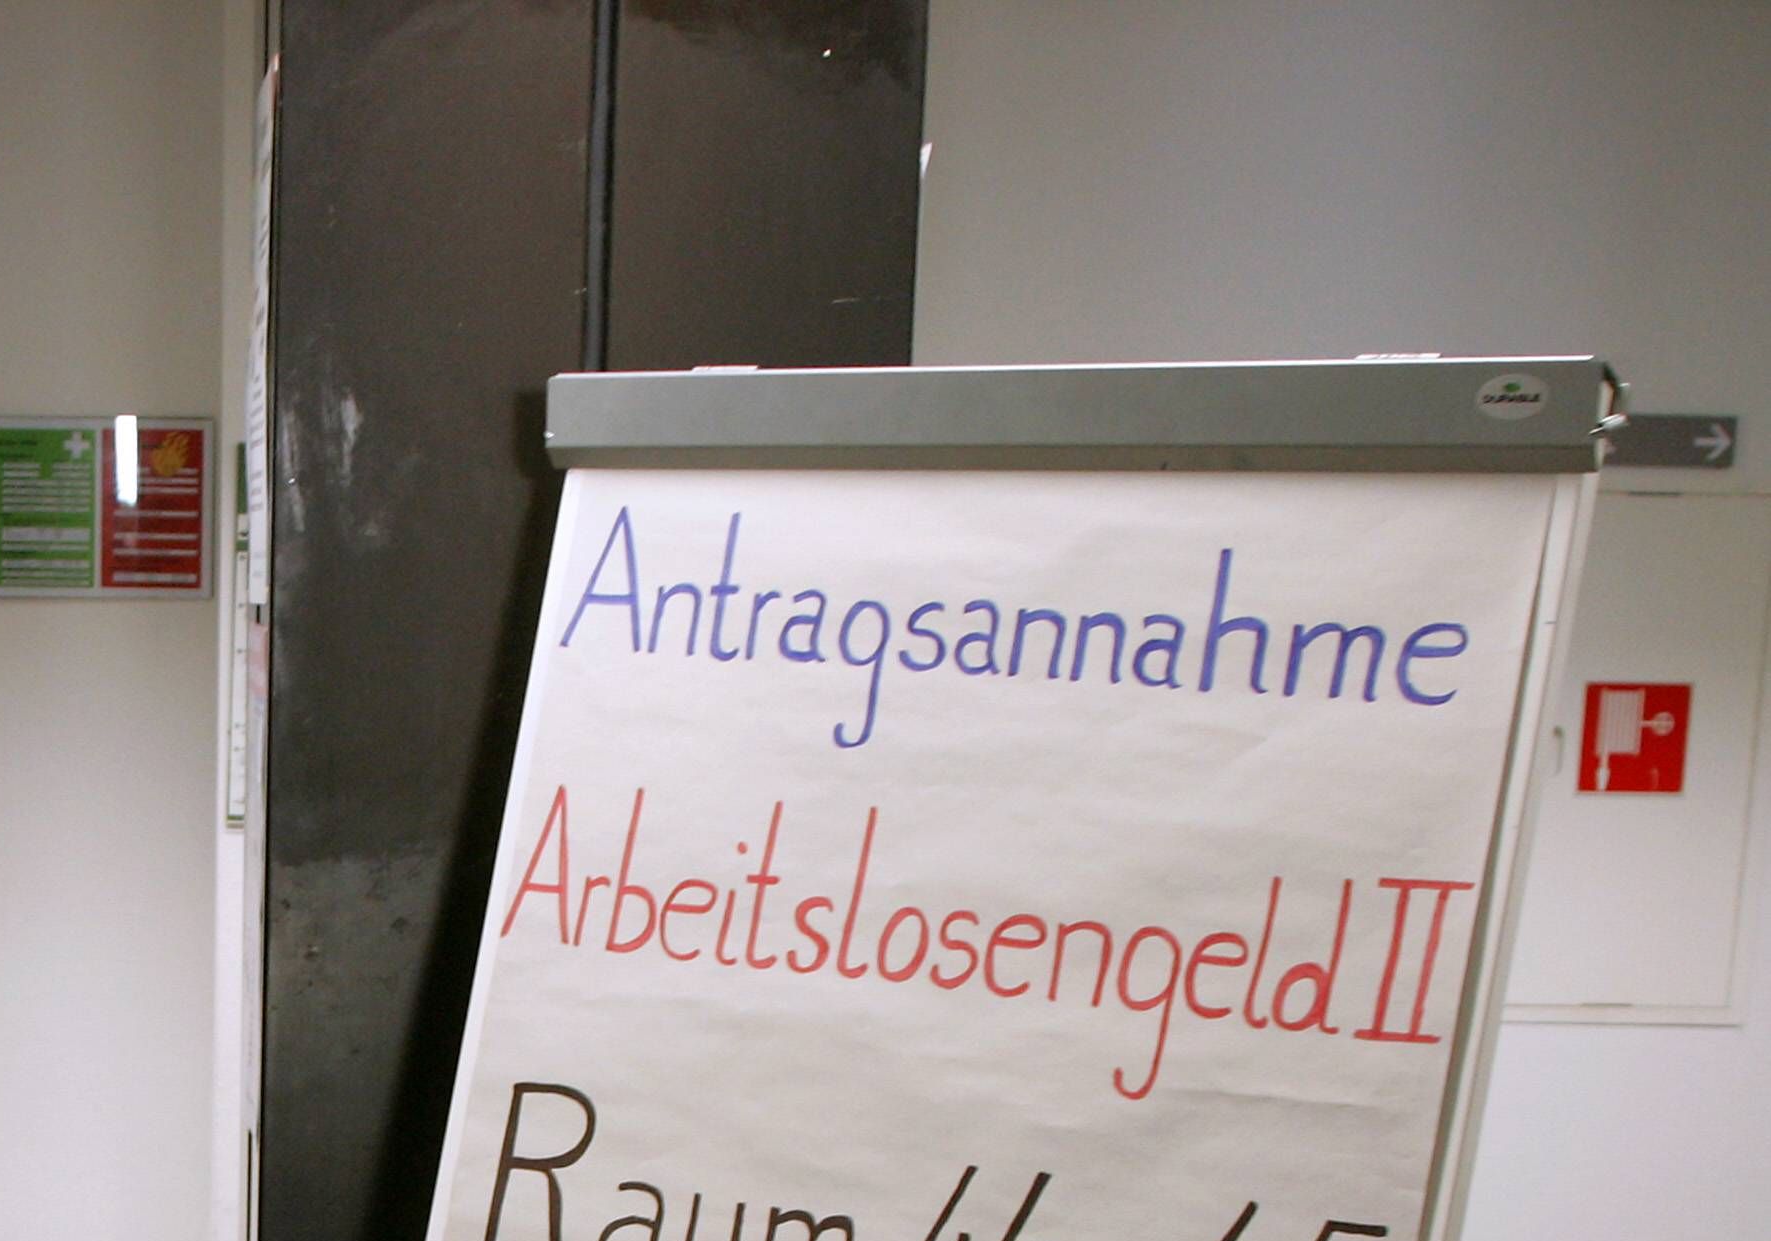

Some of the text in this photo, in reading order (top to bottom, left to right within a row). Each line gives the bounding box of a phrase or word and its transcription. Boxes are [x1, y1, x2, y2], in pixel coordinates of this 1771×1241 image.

[559, 505, 1469, 748] Antragsannahme
[499, 785, 1475, 1101] Arbeitslosengeld II
